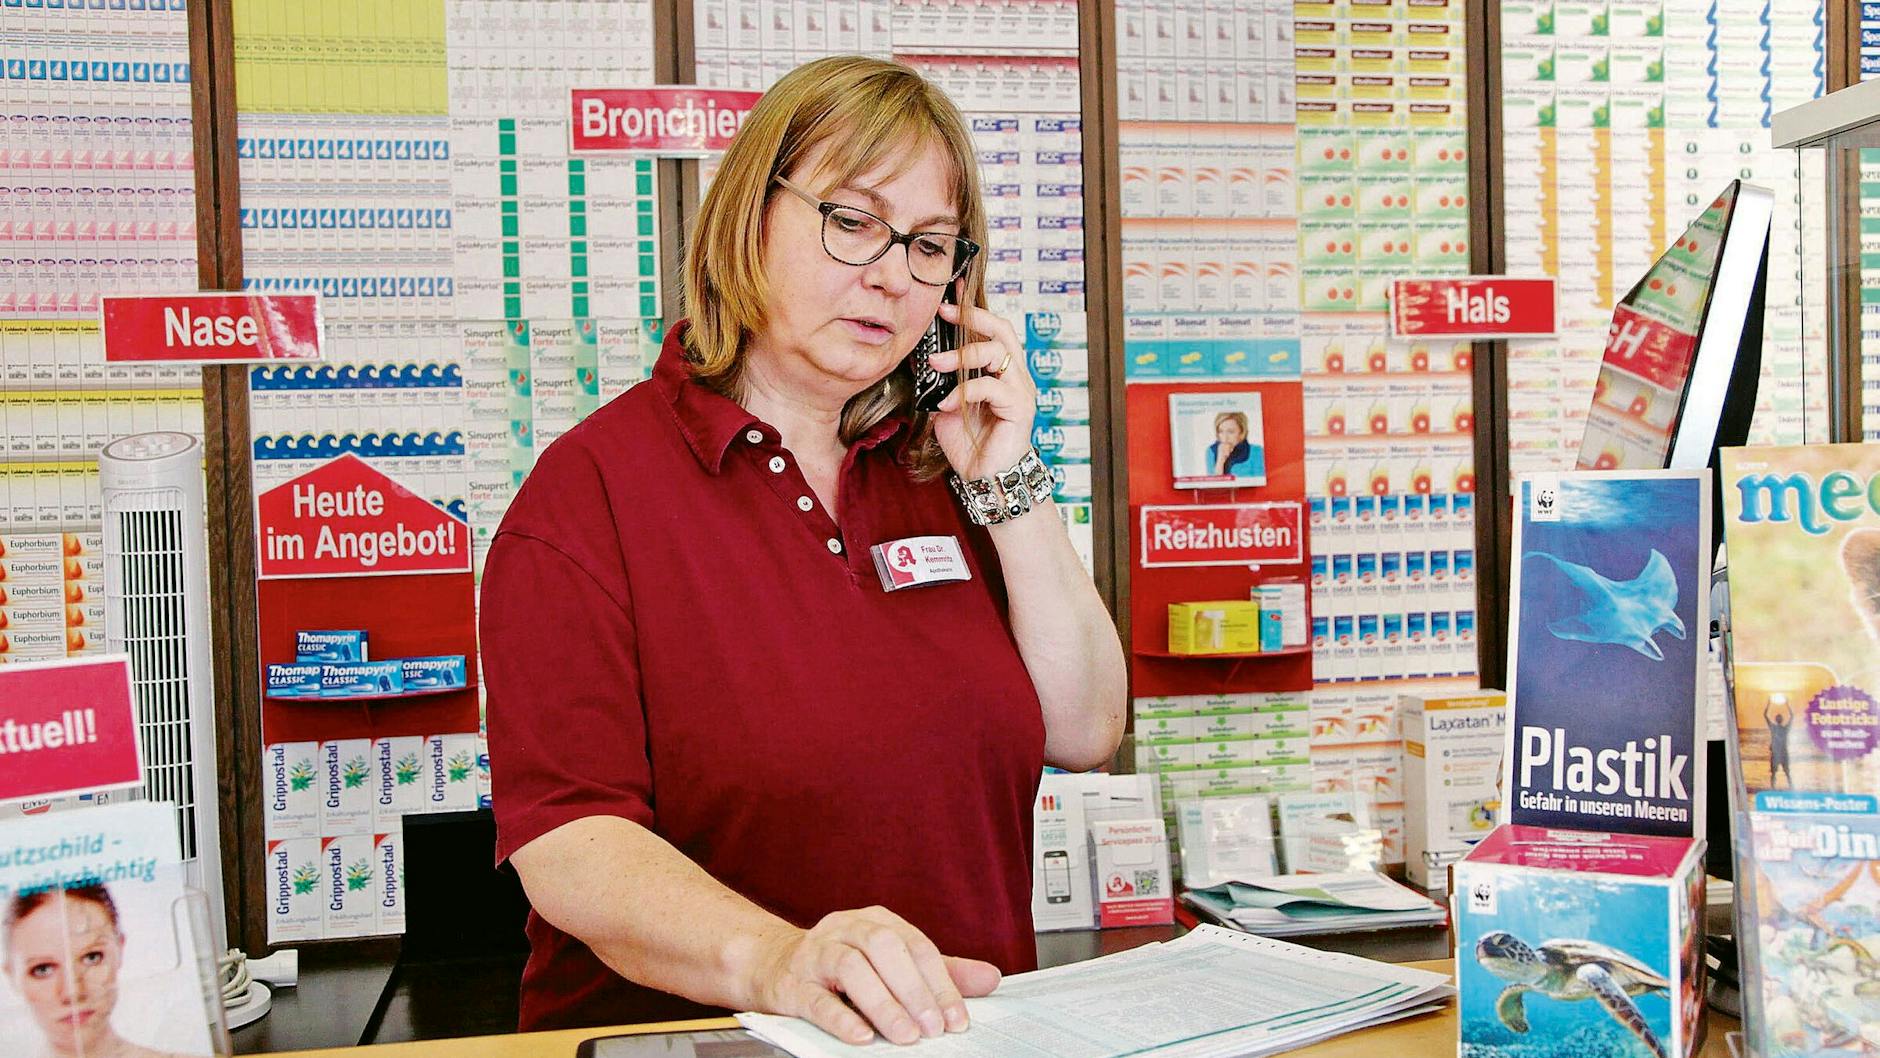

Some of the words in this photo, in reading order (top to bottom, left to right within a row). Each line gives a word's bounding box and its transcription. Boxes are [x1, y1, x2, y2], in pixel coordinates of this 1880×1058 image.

[1446, 286, 1511, 324] Hals
[163, 306, 258, 347] Nase
[463, 327, 505, 339] Sinupret
[532, 327, 573, 339] Sinupret
[599, 326, 640, 338] Sinupret
[465, 379, 506, 391] Sinupret
[534, 378, 574, 390] Sinupret
[467, 430, 507, 442] Sinupret
[468, 481, 509, 494] Sinupret
[292, 483, 385, 518] Heute
[1153, 521, 1291, 550] Reizhusten
[10, 540, 57, 550] Euphorbium
[266, 526, 304, 560] im
[314, 520, 456, 567] Angebot!
[921, 545, 936, 553] Frau
[11, 563, 58, 574] Euphorbium
[12, 587, 59, 598] Euphorbium
[13, 611, 60, 621] Euphorbium
[13, 634, 61, 645] Euphorbium
[297, 631, 357, 646] Thomapyrin
[297, 643, 326, 652] CLASSIC
[322, 663, 397, 677] Thomapyrin
[402, 658, 460, 671] omapyrin
[269, 675, 305, 685] CLASSIC
[322, 675, 359, 685] CLASSIC
[1430, 714, 1490, 732] Laxatan
[1519, 725, 1689, 801] Plastik
[326, 744, 342, 809] Grippostad
[378, 741, 395, 806] Grippostad
[430, 739, 447, 803] Grippostad
[271, 747, 288, 811] Grippostad
[1519, 789, 1564, 811] Gefahr
[1564, 795, 1578, 813] in
[1579, 799, 1633, 818] unseren
[1634, 799, 1689, 823] Meeren
[1764, 796, 1868, 812] Wissens-Poster
[1811, 823, 1880, 858] Din
[329, 847, 346, 911] Grippostad
[382, 844, 398, 908] Grippostad
[275, 851, 292, 916] Grippostad
